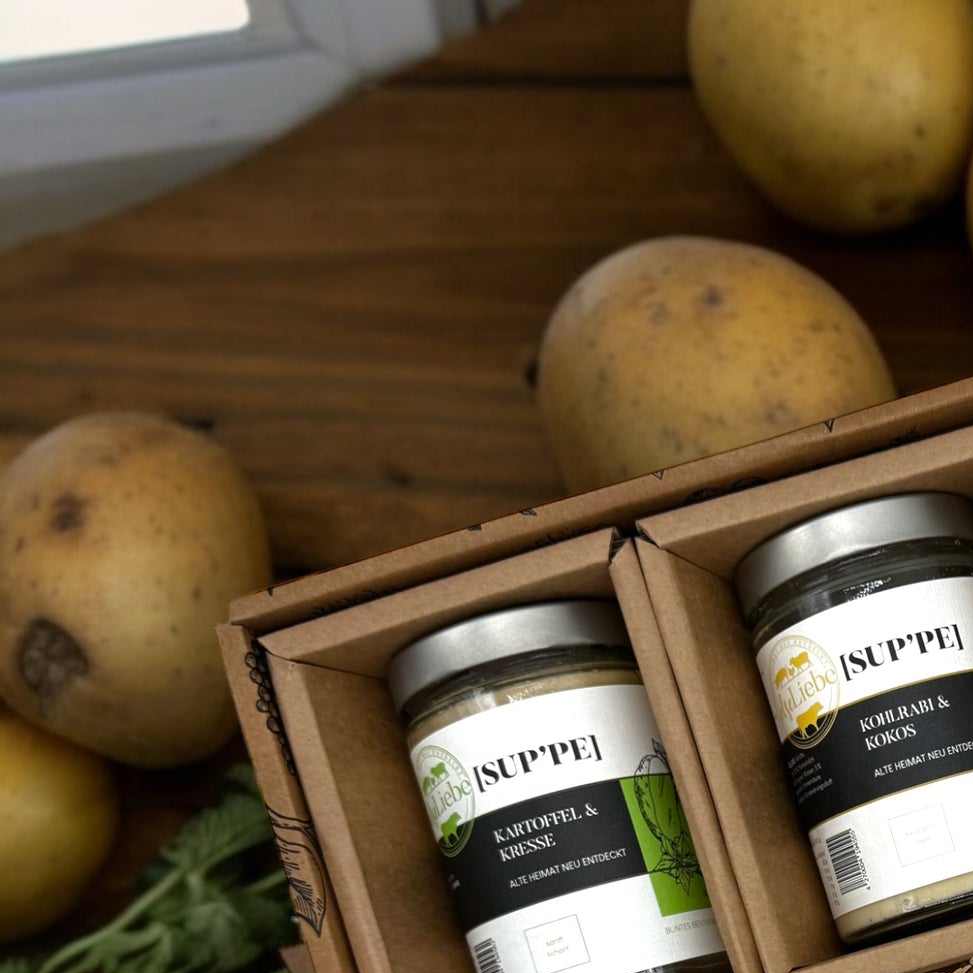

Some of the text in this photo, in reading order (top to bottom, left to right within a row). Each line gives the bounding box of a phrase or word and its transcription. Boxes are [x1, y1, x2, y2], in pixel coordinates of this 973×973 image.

[839, 623, 964, 682] [SUP'PE]
[859, 694, 950, 733] KOHLRABI &
[864, 723, 917, 751] KOKOS
[473, 734, 602, 793] [SUP'PE]
[874, 763, 894, 778] ALTE
[894, 753, 926, 772] HEIMAT
[927, 748, 946, 762] NEU
[493, 802, 599, 844] KARTOFFEL &
[499, 832, 557, 863] KRESSE
[509, 847, 627, 889] ALTE HEIMAT NEU ENTDECKT
